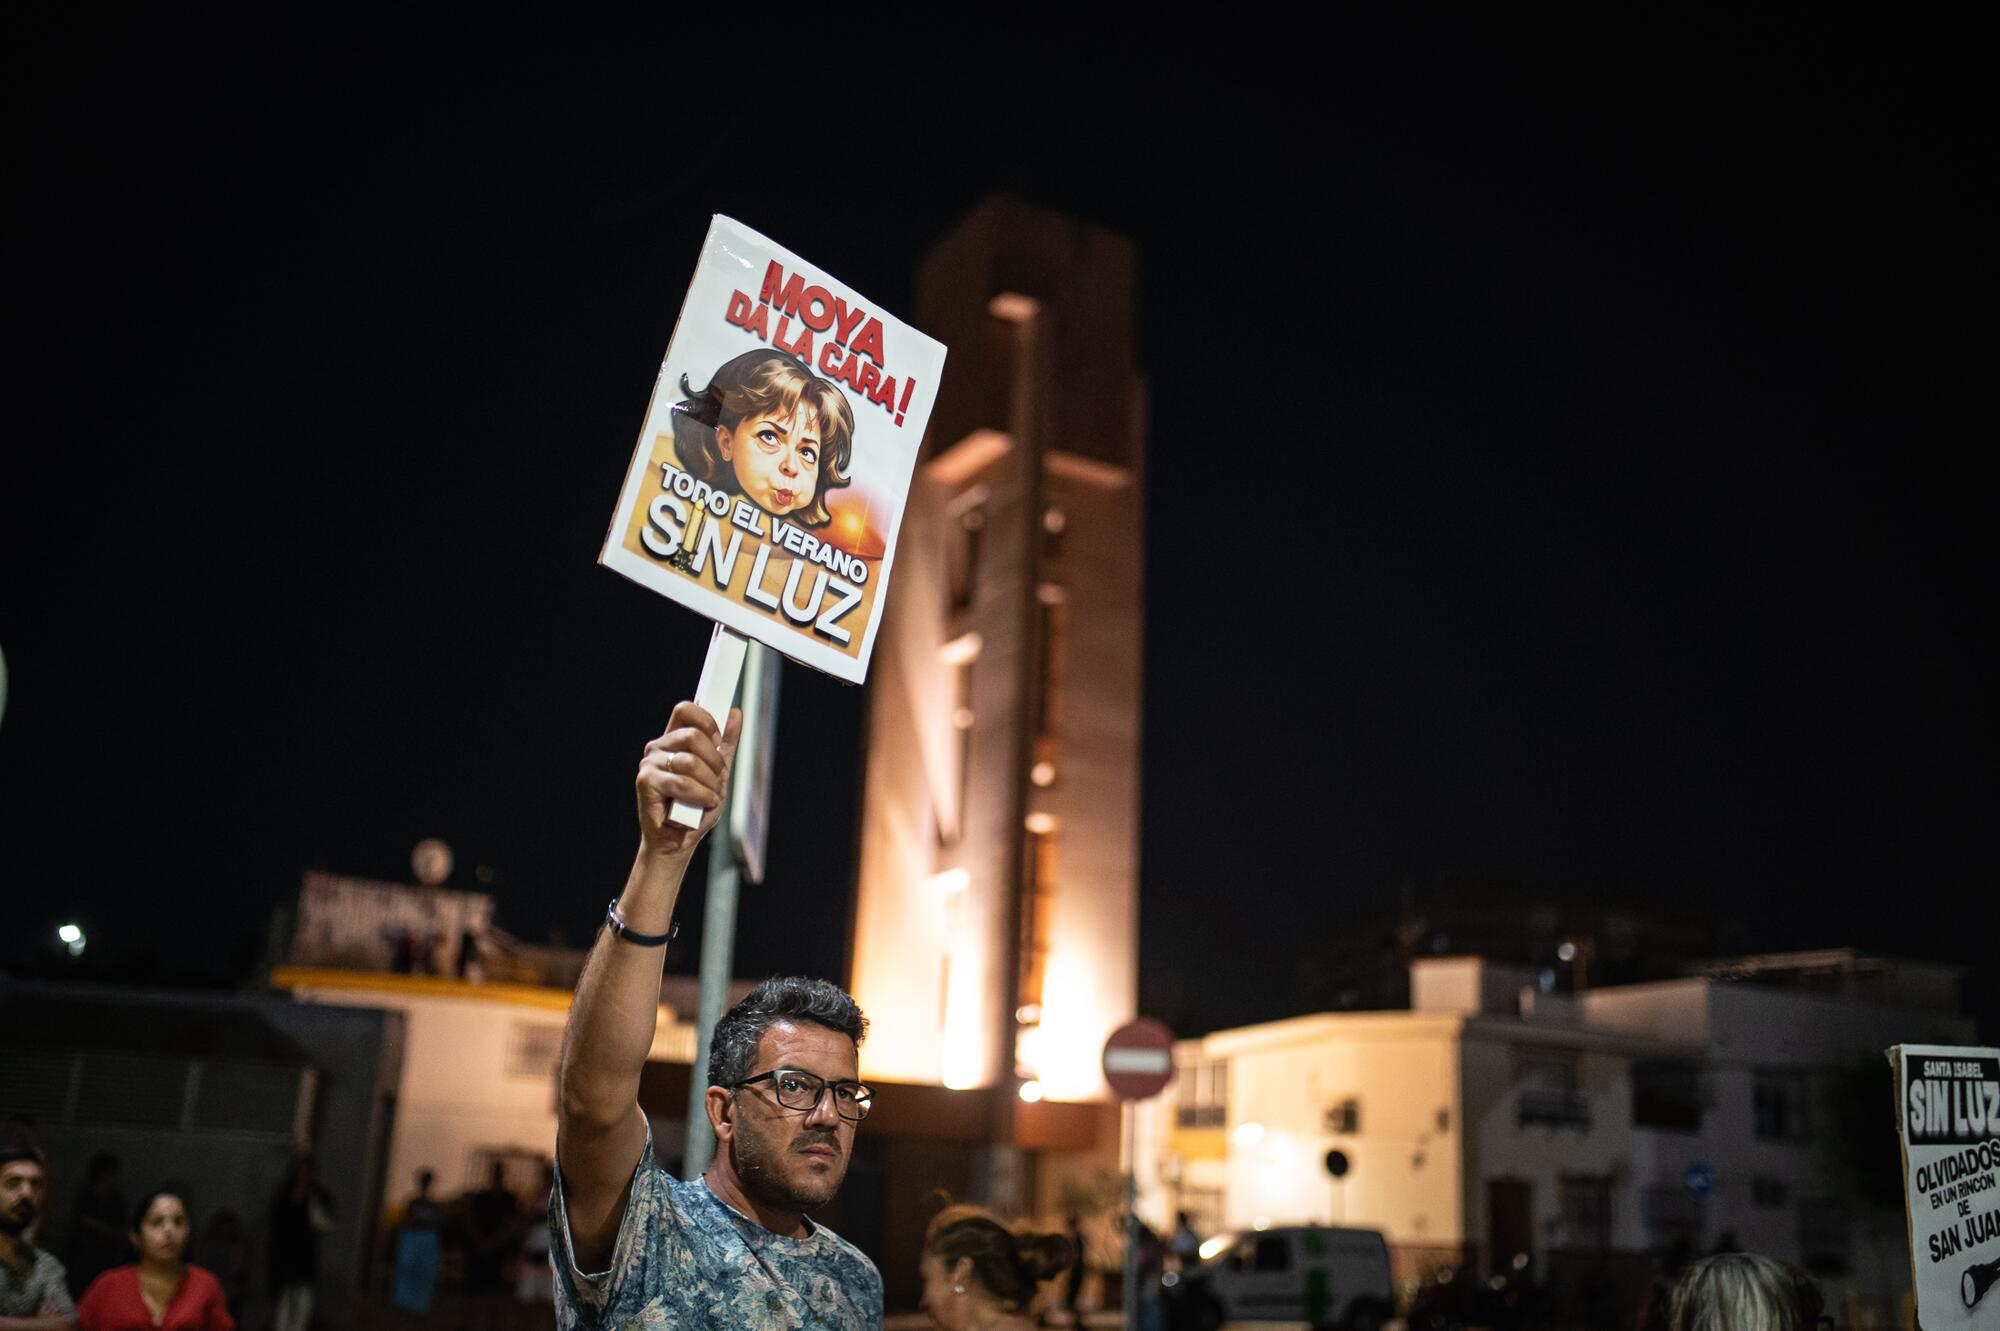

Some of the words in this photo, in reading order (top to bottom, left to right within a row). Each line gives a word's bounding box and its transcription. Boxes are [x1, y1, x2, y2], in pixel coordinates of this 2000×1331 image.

[759, 259, 884, 369] MOYA
[725, 289, 768, 341] DA
[772, 315, 813, 366] LA
[818, 342, 916, 427] CARA!
[661, 462, 730, 518] TODO
[732, 500, 763, 537] EL
[771, 517, 868, 584] VERANO
[641, 494, 743, 589] SIN
[744, 543, 862, 644] LUZ
[1924, 1060, 1951, 1077] SANTA
[1953, 1061, 1983, 1078] ISABEL
[1909, 1079, 1949, 1136] SIN
[1954, 1080, 2000, 1136] LUZ
[1916, 1142, 2000, 1194] OLVIDADOS
[1930, 1193, 1943, 1210] EN
[1943, 1188, 1957, 1206] UN
[1957, 1172, 1996, 1200] RINCÓN
[1957, 1199, 1971, 1218] DE
[1929, 1224, 1962, 1263] SAN
